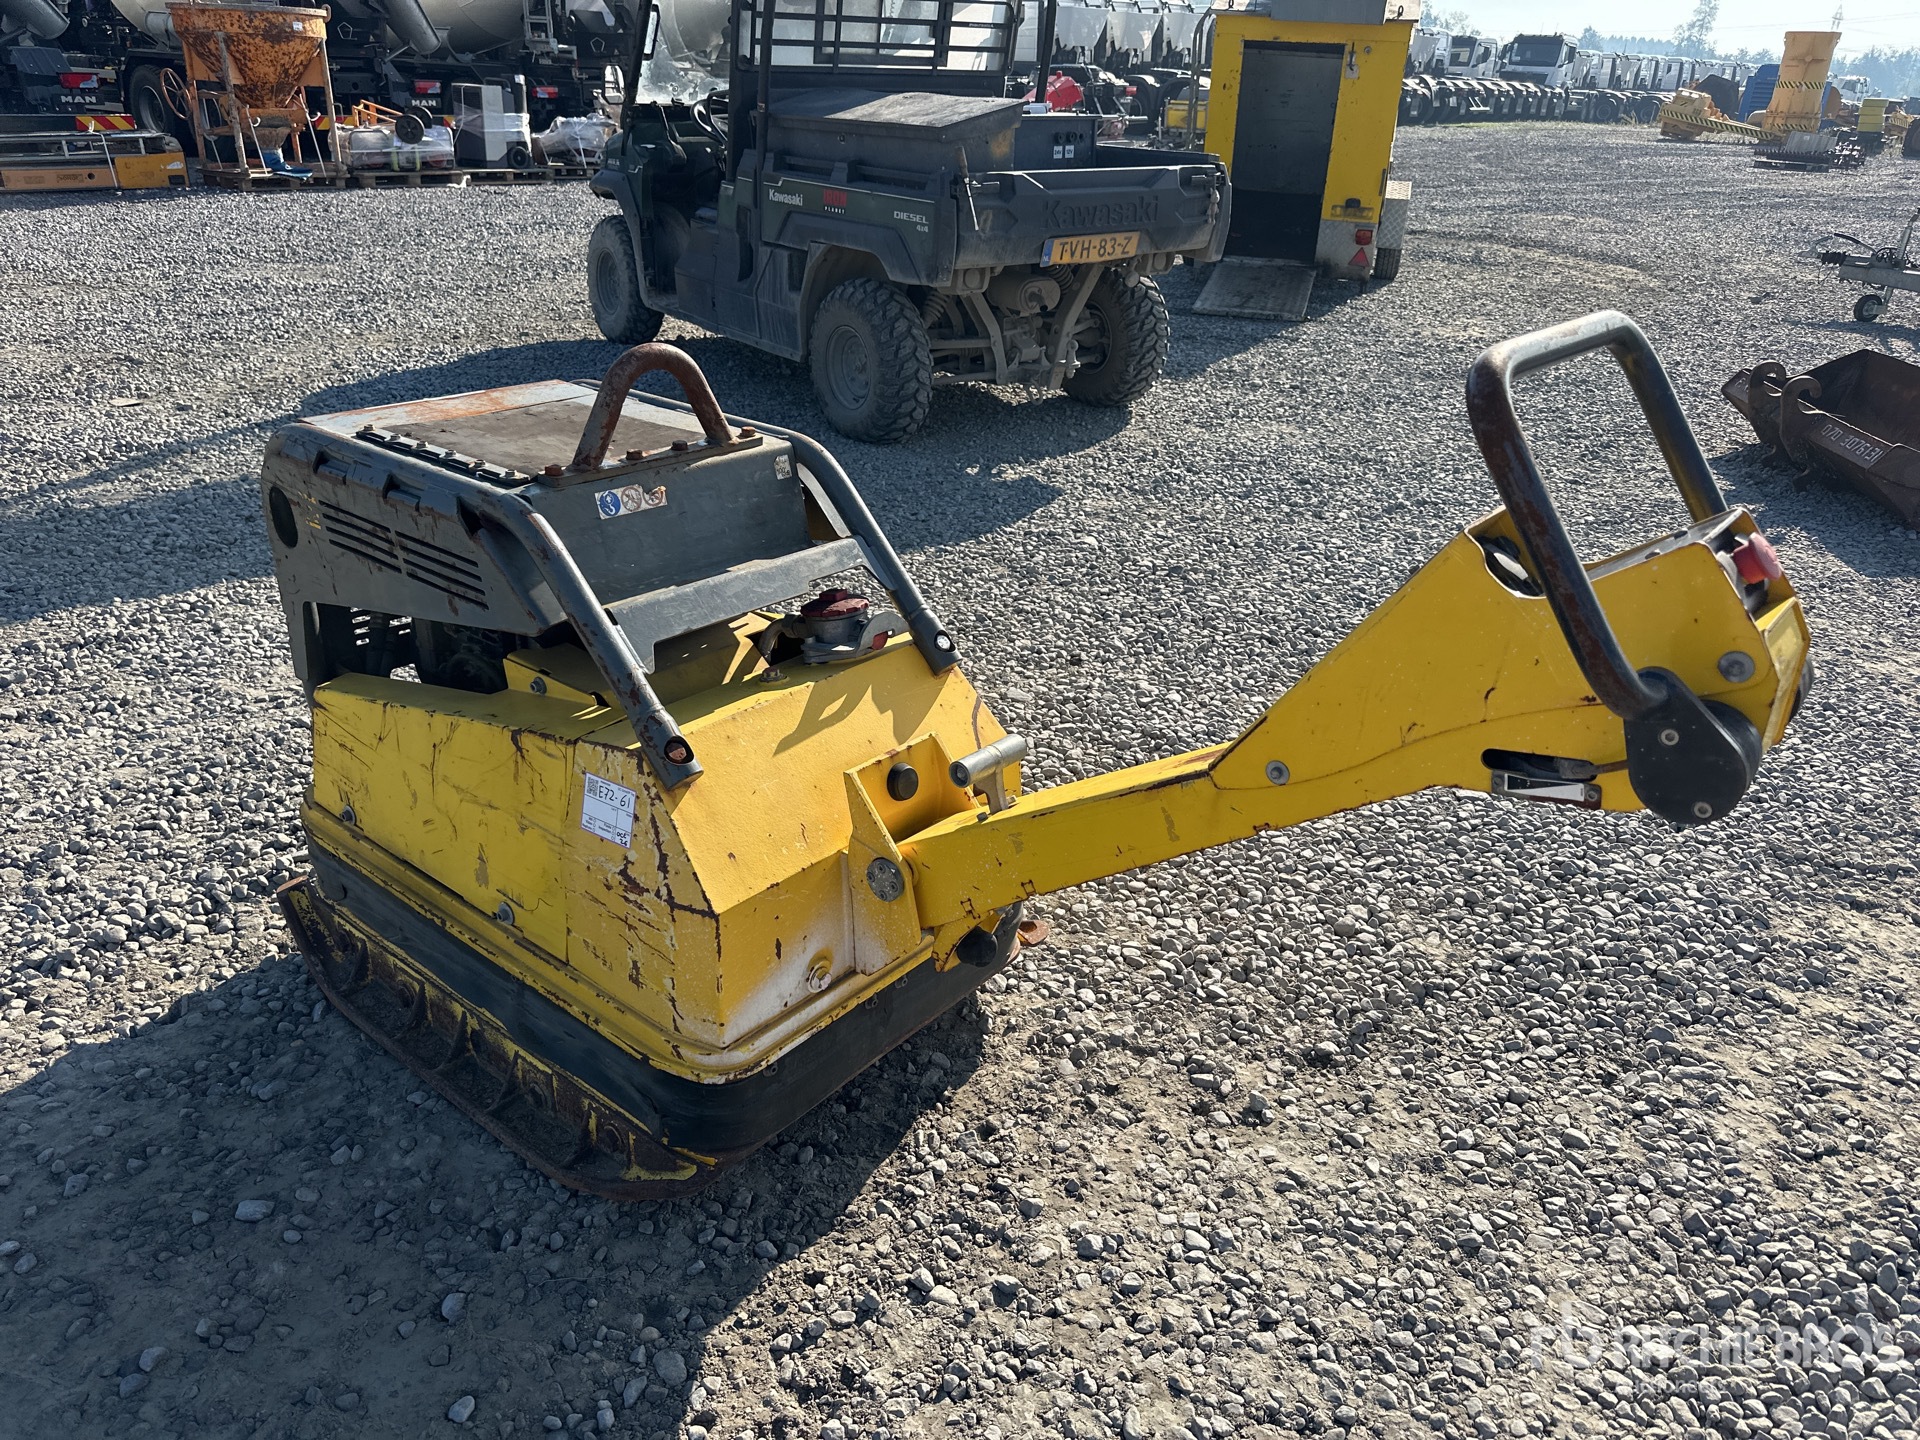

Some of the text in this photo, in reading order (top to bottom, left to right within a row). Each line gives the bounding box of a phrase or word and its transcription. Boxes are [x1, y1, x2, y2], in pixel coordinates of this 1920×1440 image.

[769, 188, 803, 206] Kawasaki
[823, 189, 847, 207] IRON
[824, 206, 845, 214] PLANET
[893, 210, 929, 224] DIESEL
[1042, 196, 1159, 230] Kawasaki
[1059, 236, 1133, 261] TVH-83-Z
